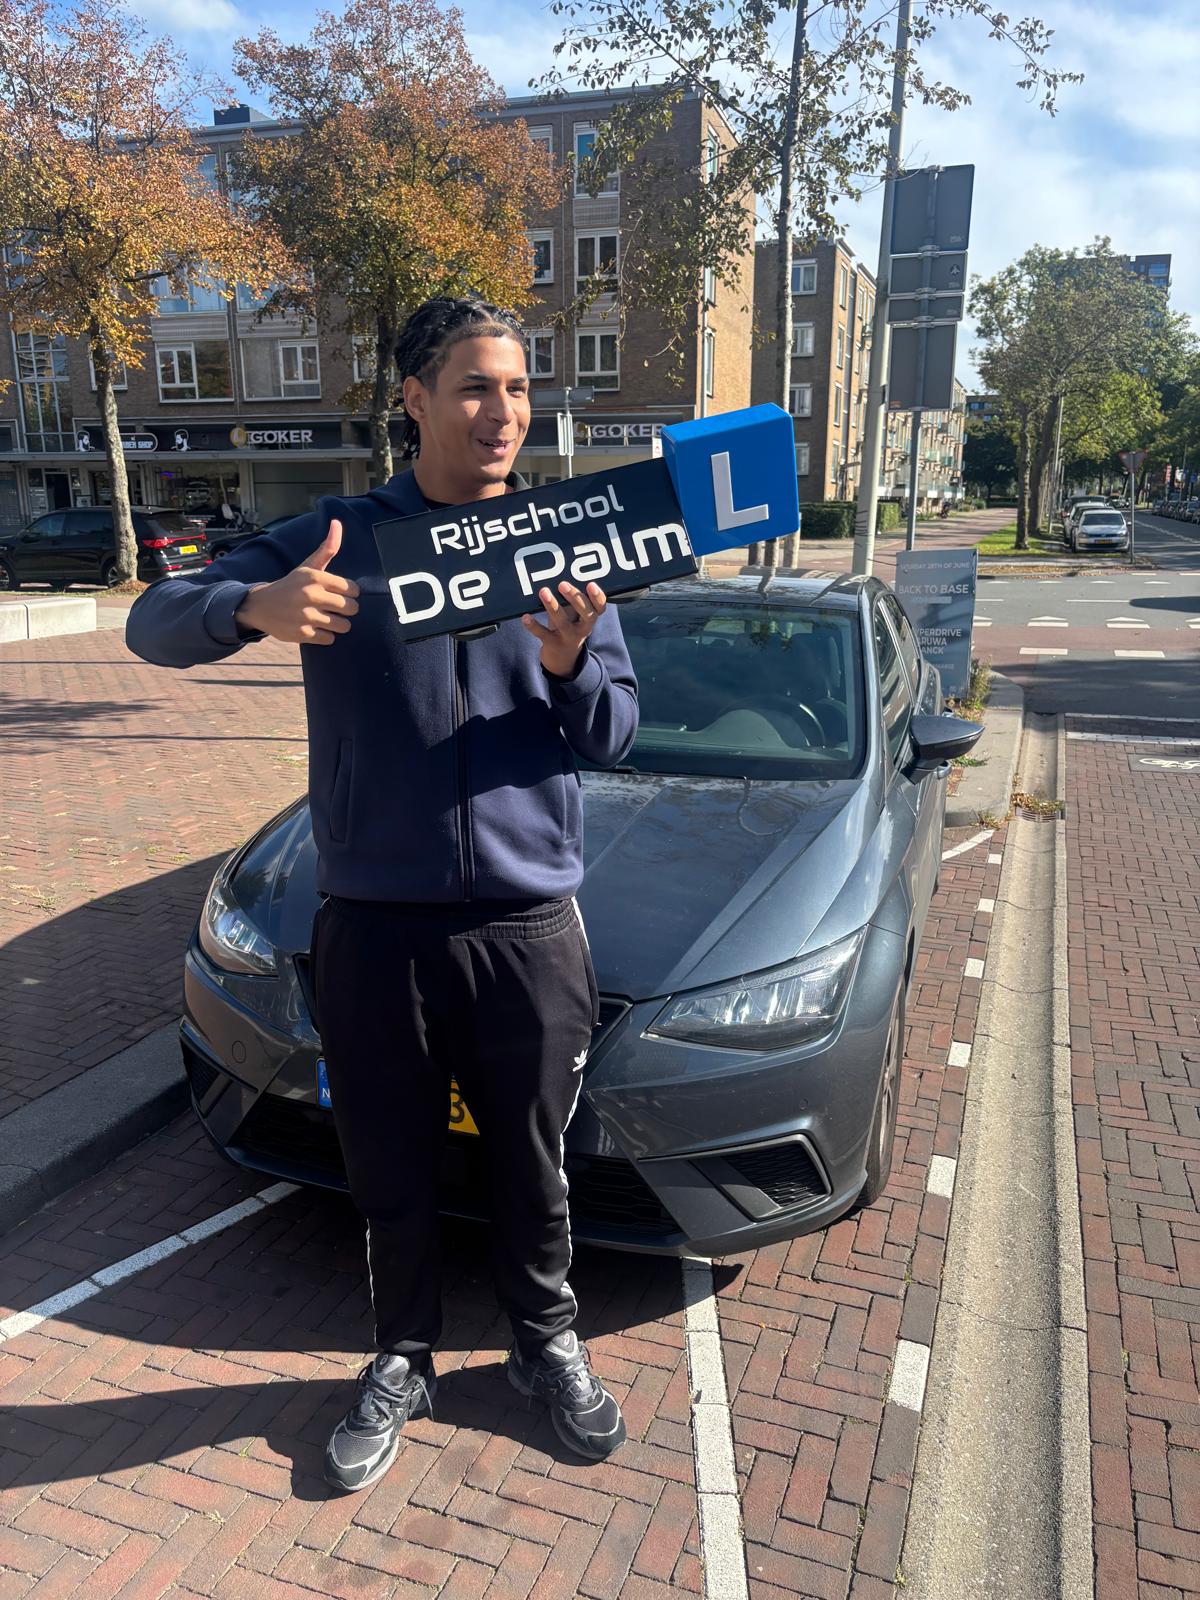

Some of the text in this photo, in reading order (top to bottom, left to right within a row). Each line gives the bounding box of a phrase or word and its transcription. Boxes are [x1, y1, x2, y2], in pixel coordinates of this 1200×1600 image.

[250, 430, 313, 444] GOKER
[592, 424, 665, 438] GOKER
[138, 441, 153, 449] SHOP
[710, 451, 769, 531] L
[430, 484, 624, 556] Rijschool
[389, 522, 692, 625] De Palm
[899, 584, 969, 594] BACK TO BASE
[921, 646, 944, 655] ANCK
